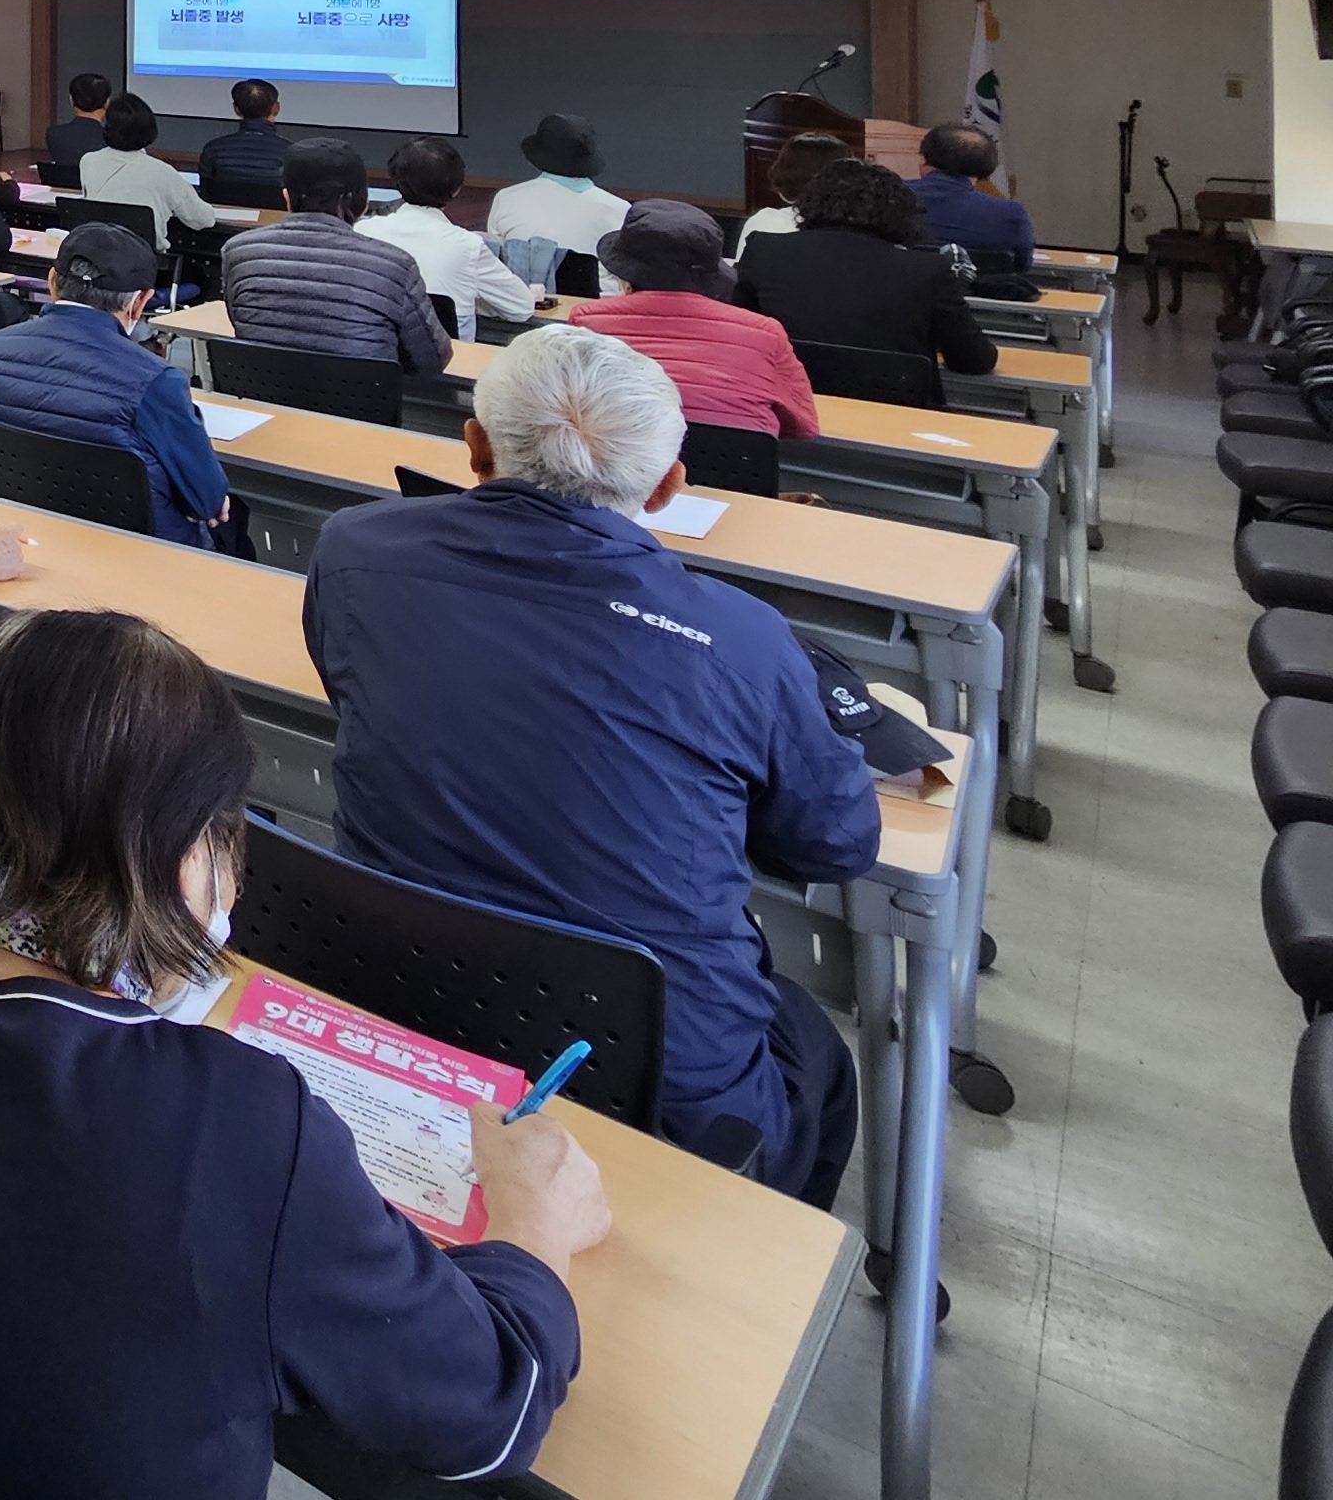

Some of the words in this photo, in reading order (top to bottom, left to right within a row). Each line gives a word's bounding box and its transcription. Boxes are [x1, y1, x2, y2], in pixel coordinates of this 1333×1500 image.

[170, 9, 212, 23] 뇌졸중
[216, 9, 244, 23] 발생
[297, 11, 373, 26] 뇌졸중으로
[377, 12, 411, 27] 사망
[262, 1000, 327, 1039] 9대
[336, 1028, 497, 1103] 생활수칙
[440, 1056, 469, 1073] 위한
